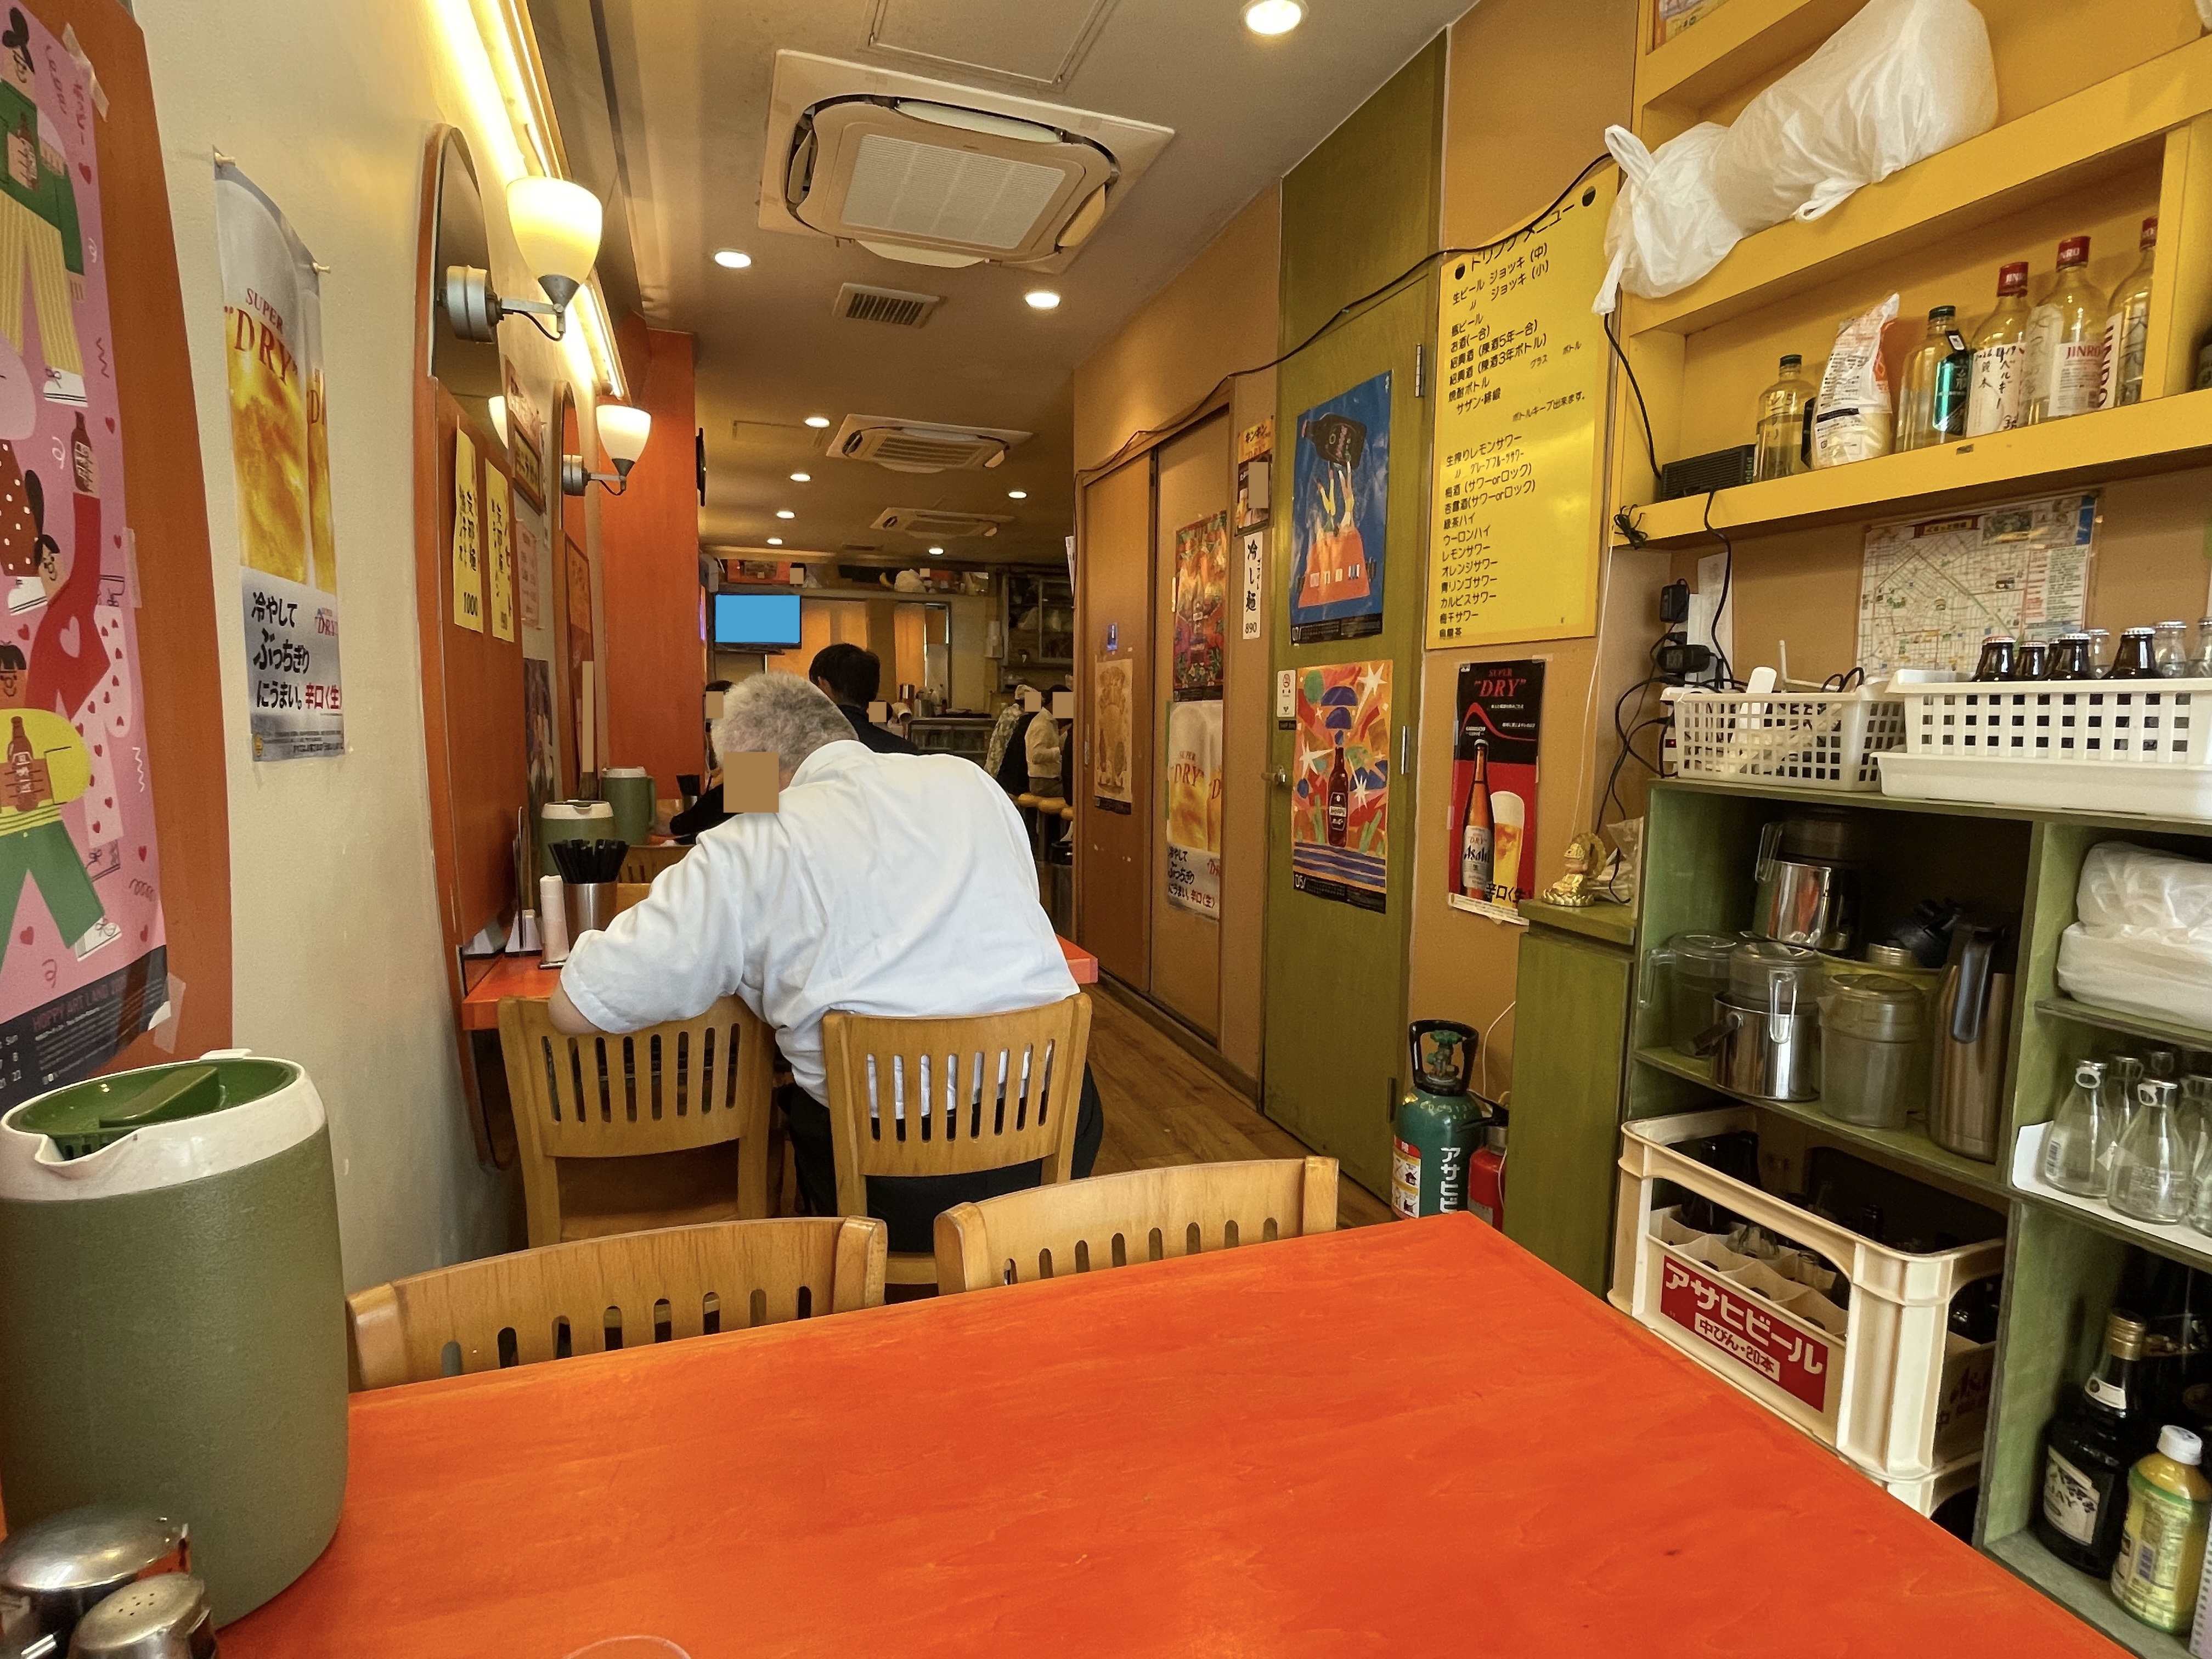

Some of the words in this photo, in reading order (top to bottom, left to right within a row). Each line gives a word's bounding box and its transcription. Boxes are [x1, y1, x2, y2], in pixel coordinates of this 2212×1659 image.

[1453, 279, 1485, 305] 生ビール
[1530, 242, 1548, 263] (中)
[1532, 260, 1549, 280] (小)
[246, 287, 284, 336] SUPER
[2066, 344, 2101, 360] JINRO
[1442, 542, 1491, 563] レモンサワー
[1443, 524, 1491, 546] ウーロンハイ
[1441, 558, 1498, 578] オレンジサワー
[251, 591, 298, 628] 冷やして
[252, 628, 310, 674] ぶっちぎり
[1666, 1262, 1823, 1374] アサヒビール
[1699, 1319, 1775, 1374] 中びん・20本
